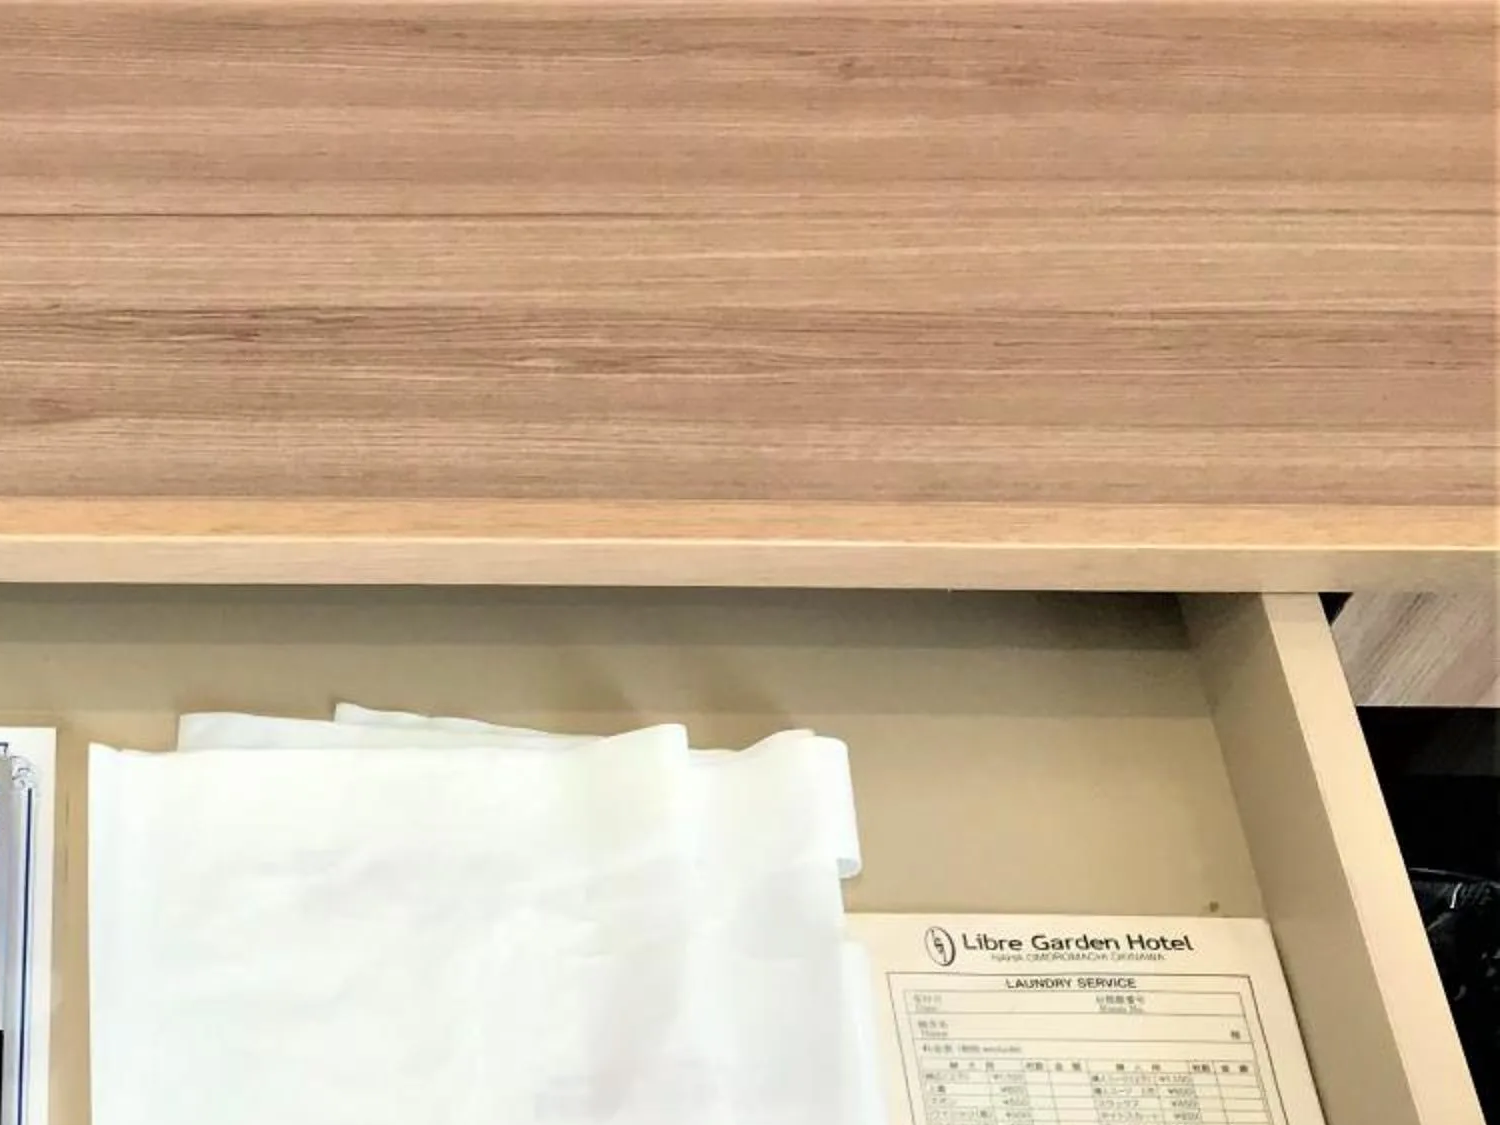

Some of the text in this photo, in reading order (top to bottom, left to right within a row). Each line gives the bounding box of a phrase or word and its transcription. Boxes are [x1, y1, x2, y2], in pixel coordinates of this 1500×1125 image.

[962, 933, 1194, 951] Libre Garden Hotel
[1005, 977, 1137, 989] LAUNDRY SERVICE
